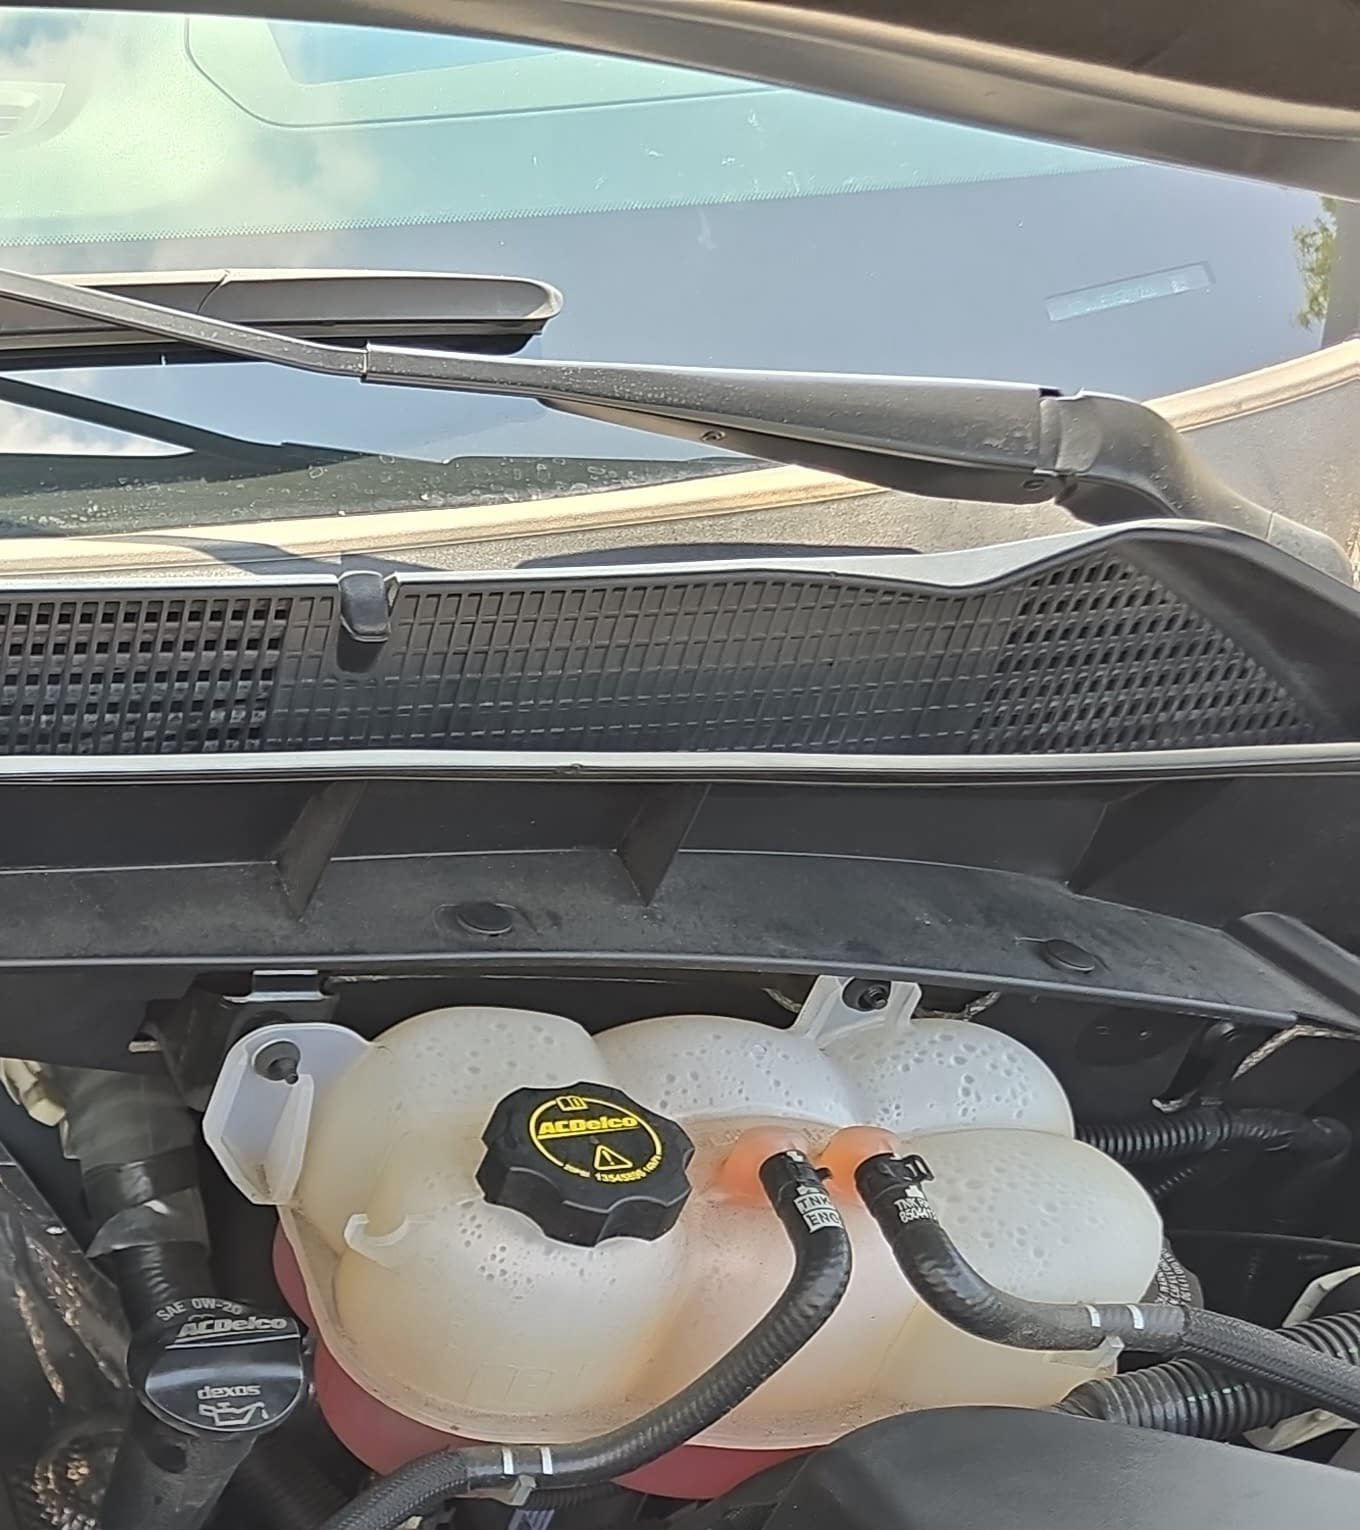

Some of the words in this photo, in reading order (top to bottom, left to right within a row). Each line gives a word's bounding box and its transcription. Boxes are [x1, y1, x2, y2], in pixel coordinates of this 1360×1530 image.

[538, 1116, 638, 1135] ACDelco
[156, 1301, 186, 1321] SAE
[179, 1316, 287, 1338] ACDelco
[197, 1385, 262, 1400] dexos
